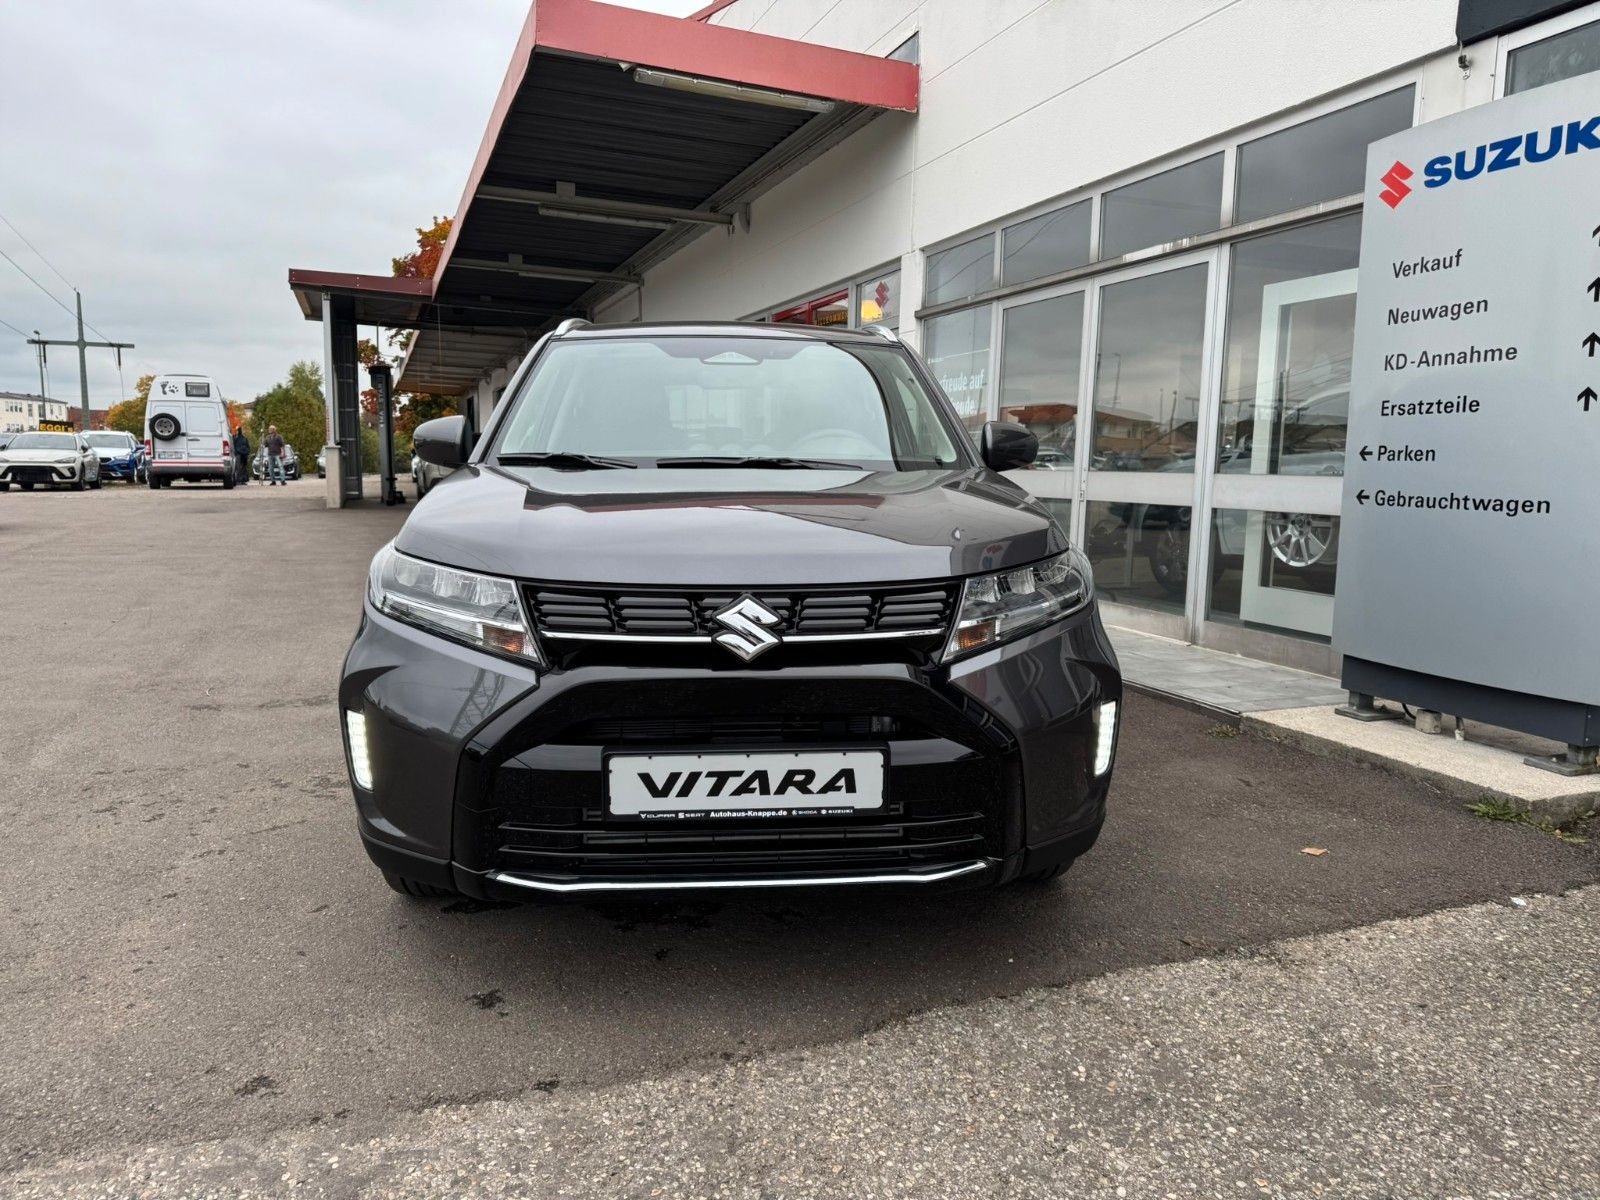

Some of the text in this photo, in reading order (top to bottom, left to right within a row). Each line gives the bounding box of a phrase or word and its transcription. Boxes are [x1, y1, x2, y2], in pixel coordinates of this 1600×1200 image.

[1392, 248, 1463, 279] Verkauf
[1387, 298, 1489, 326] Neuwagen
[1384, 346, 1518, 371] KD-Annahme
[969, 368, 985, 390] auf
[1380, 395, 1481, 417] Ersatzteile
[1377, 445, 1436, 462] Parken
[1374, 490, 1551, 517] Gebrauchtwagen
[637, 768, 858, 798] VITARA
[710, 809, 788, 818] Autohaus-Knappe.de
